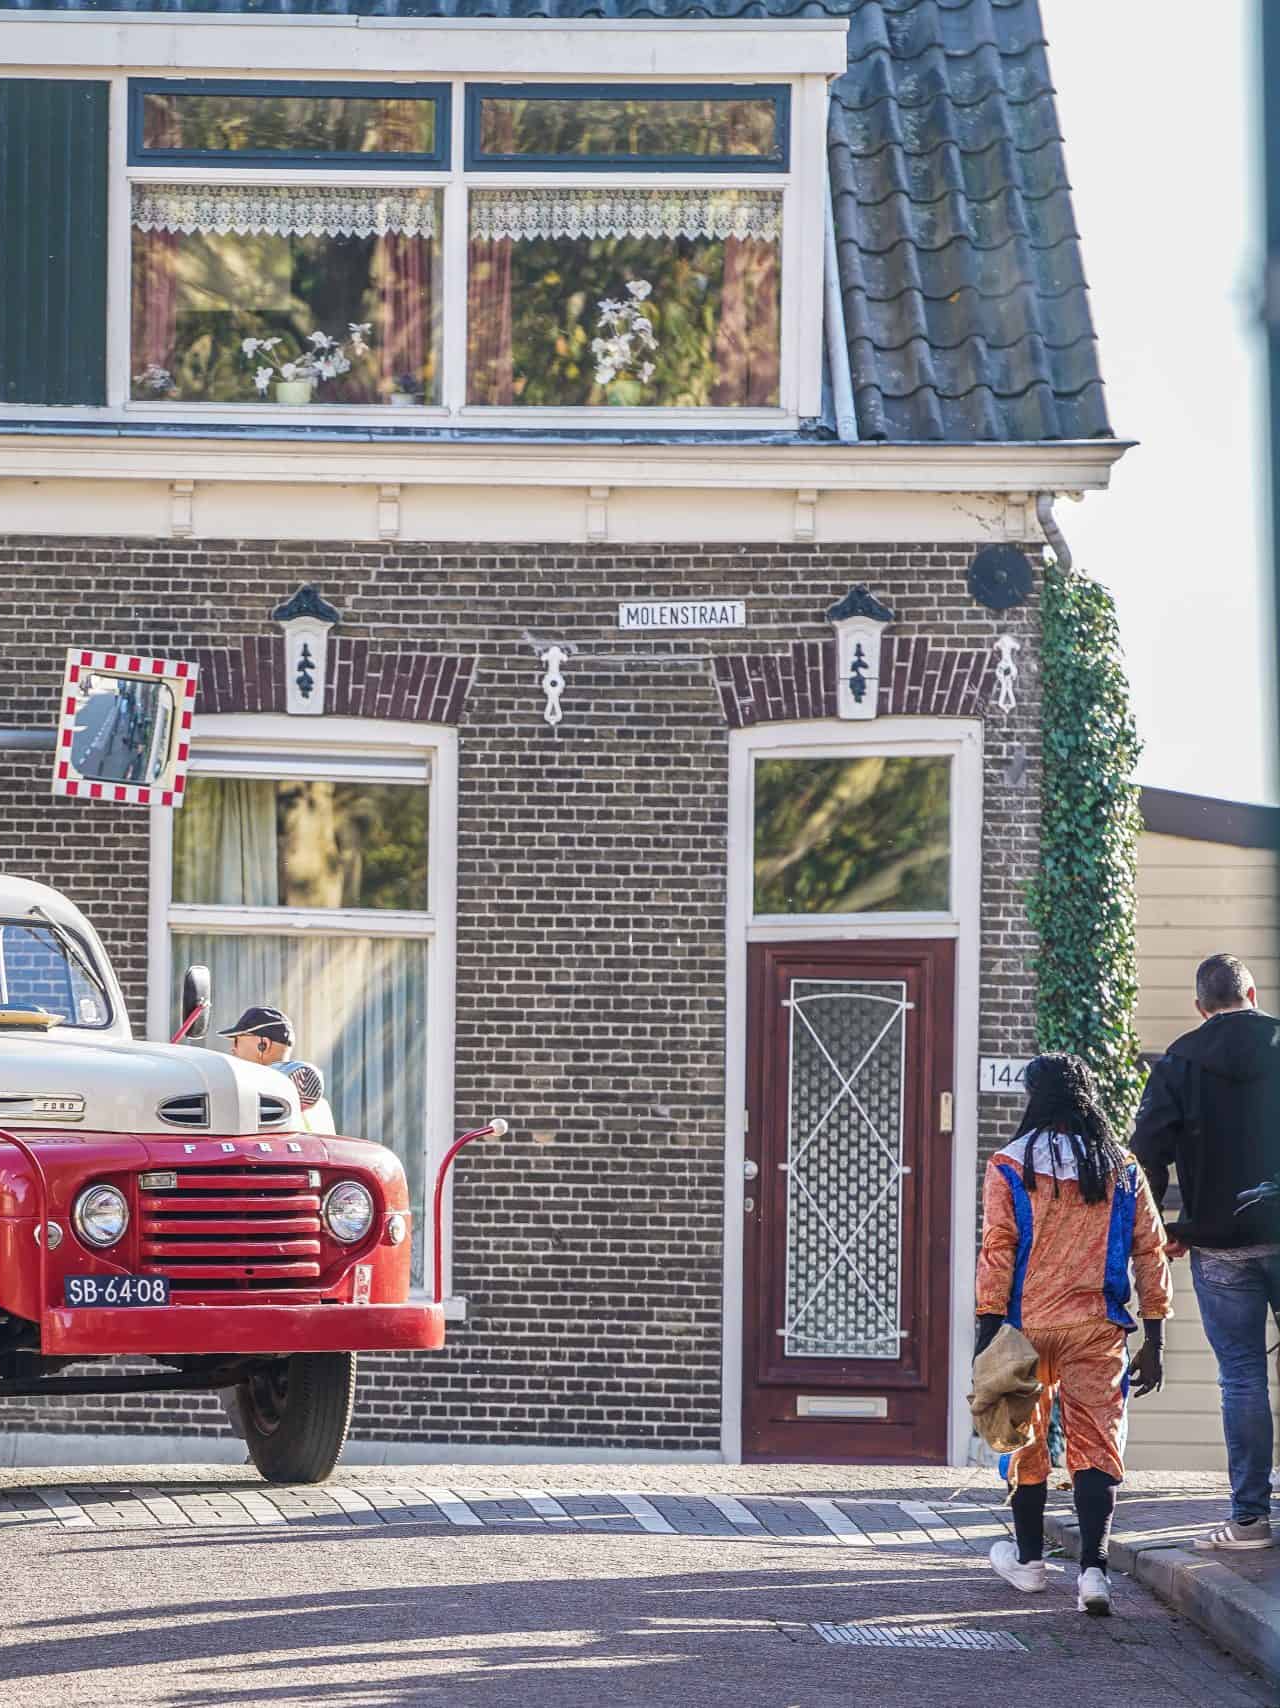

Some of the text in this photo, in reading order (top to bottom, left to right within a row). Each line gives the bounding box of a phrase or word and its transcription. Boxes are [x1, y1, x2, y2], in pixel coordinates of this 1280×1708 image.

[626, 605, 737, 625] MOLENSTRAAT
[183, 1142, 302, 1154] FORD
[69, 1279, 166, 1304] SB-64-08
